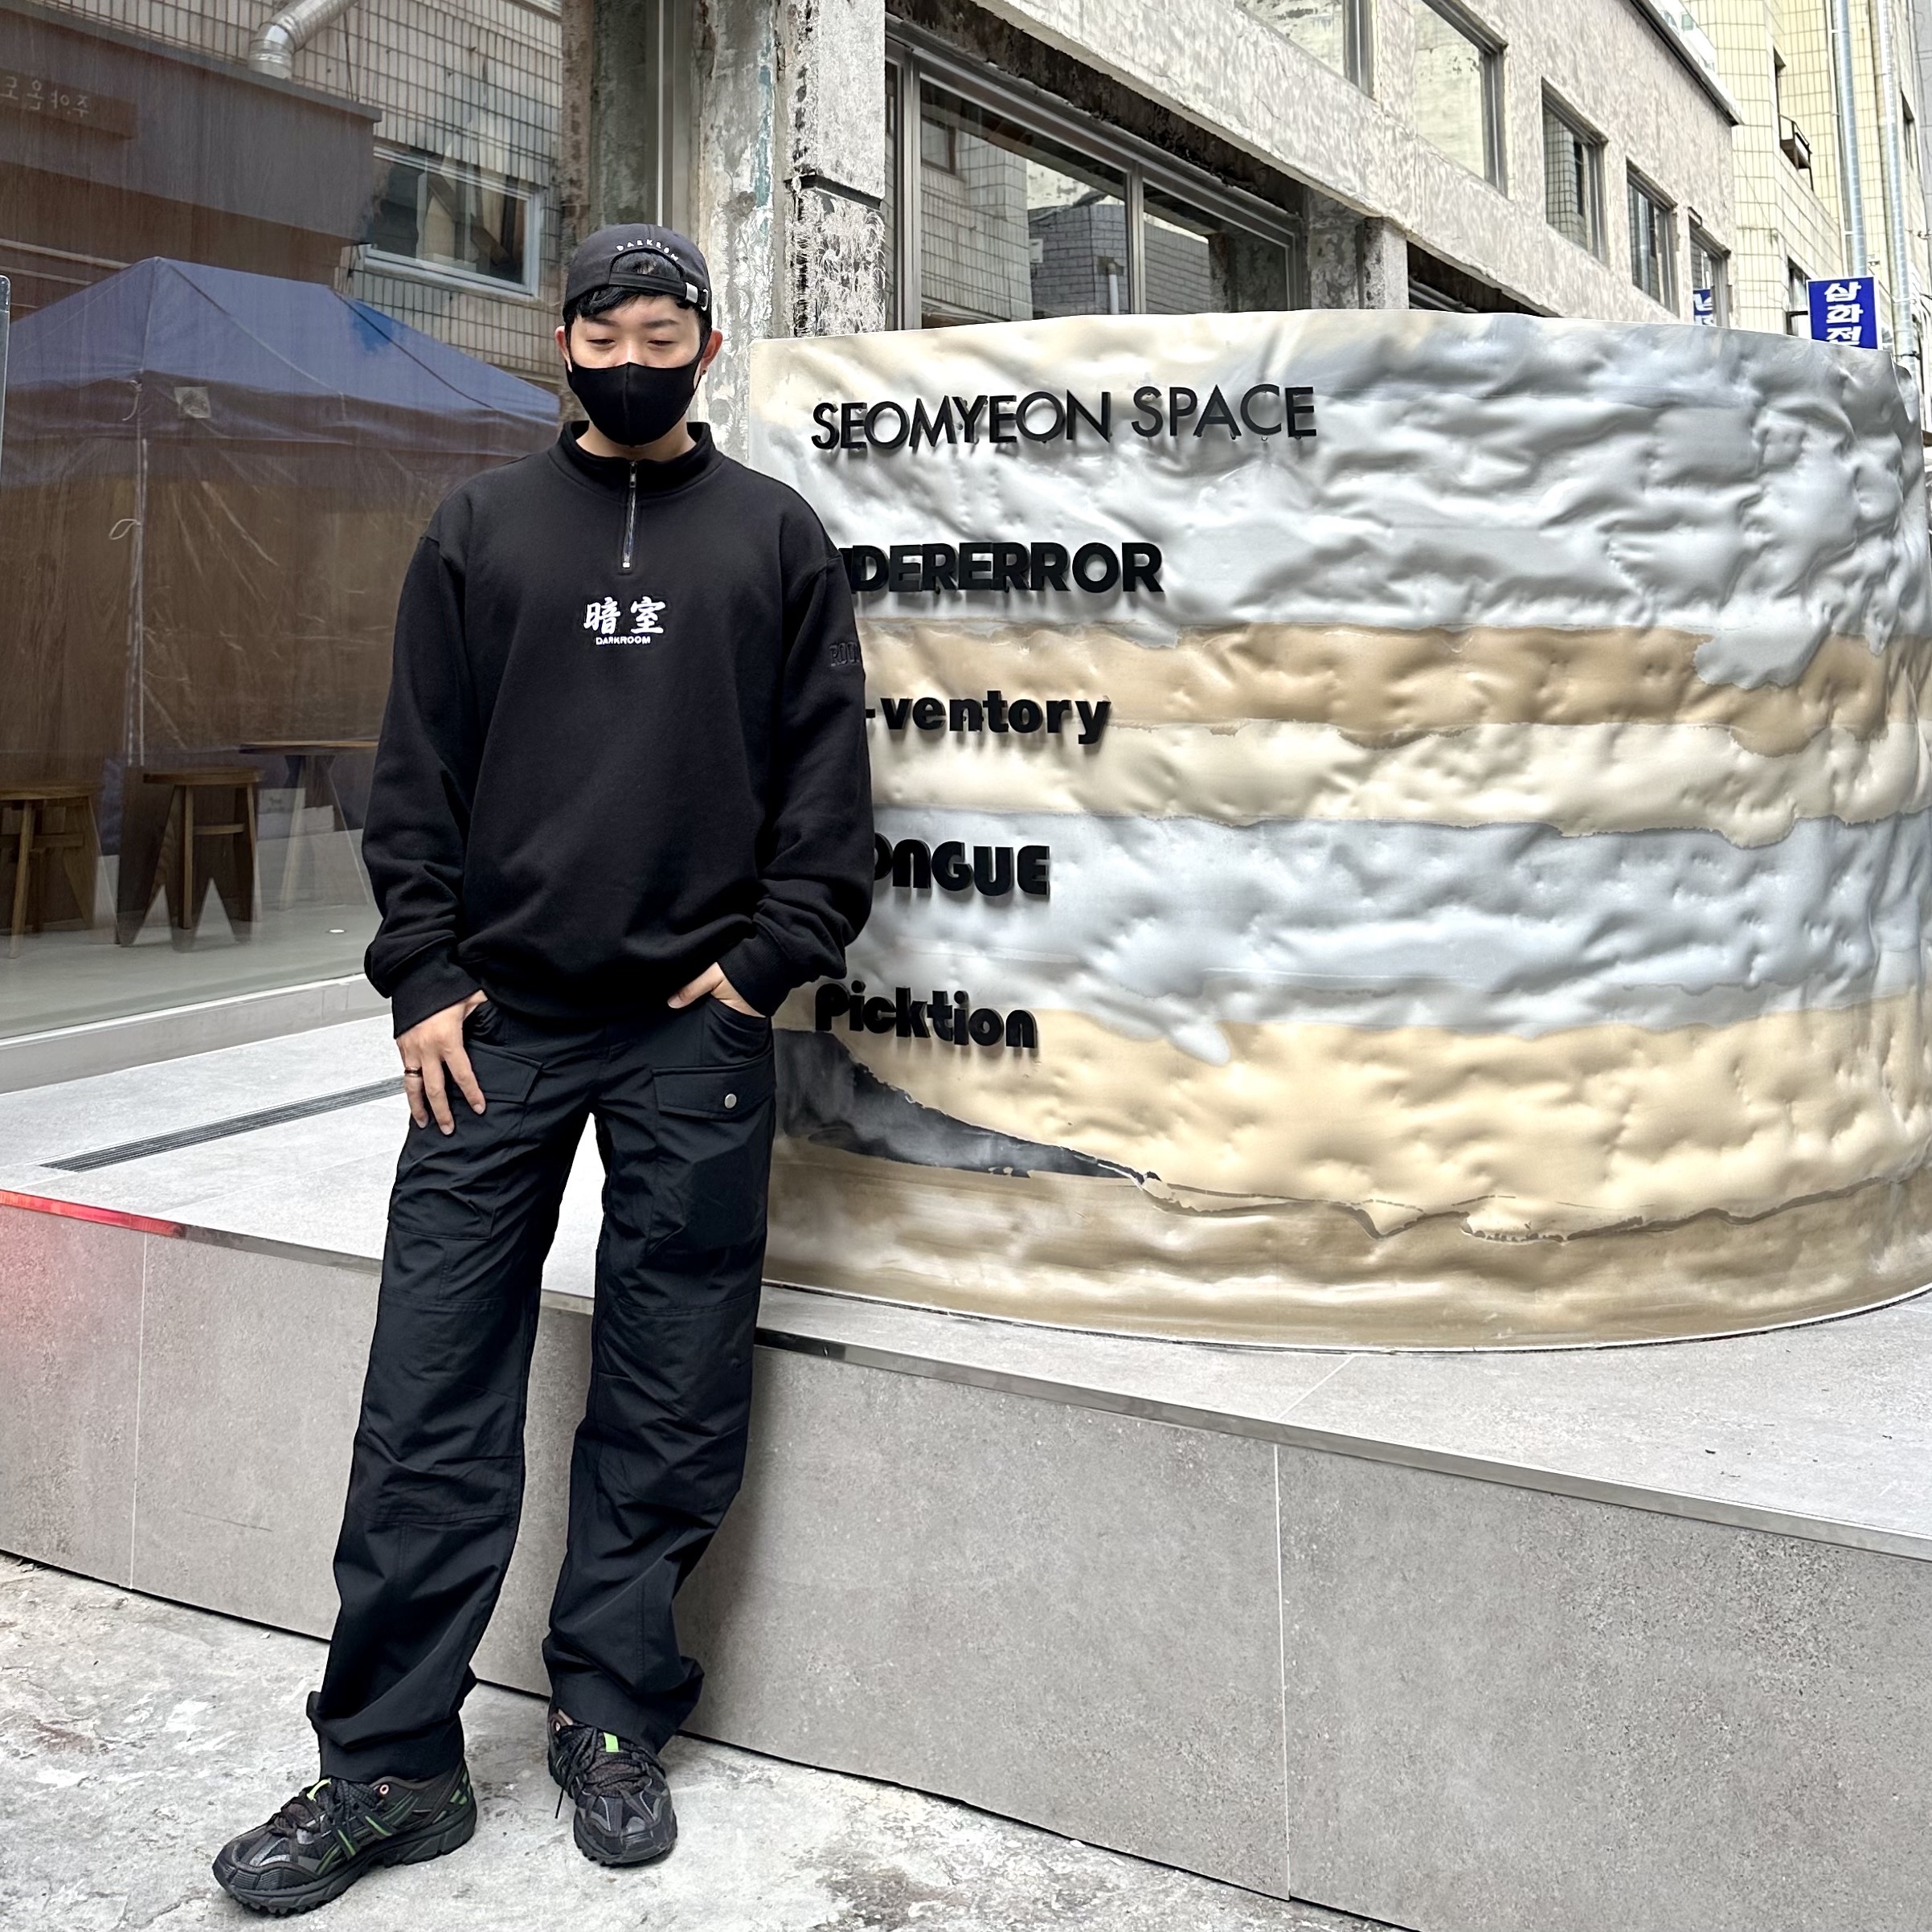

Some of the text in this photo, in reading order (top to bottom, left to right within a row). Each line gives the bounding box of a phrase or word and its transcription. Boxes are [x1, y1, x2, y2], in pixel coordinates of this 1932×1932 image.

[811, 383, 1317, 450] SEOMYEON SPACE
[583, 596, 666, 634] 暗室
[596, 636, 651, 645] DARKROOM
[815, 979, 1039, 1049] Picktion
